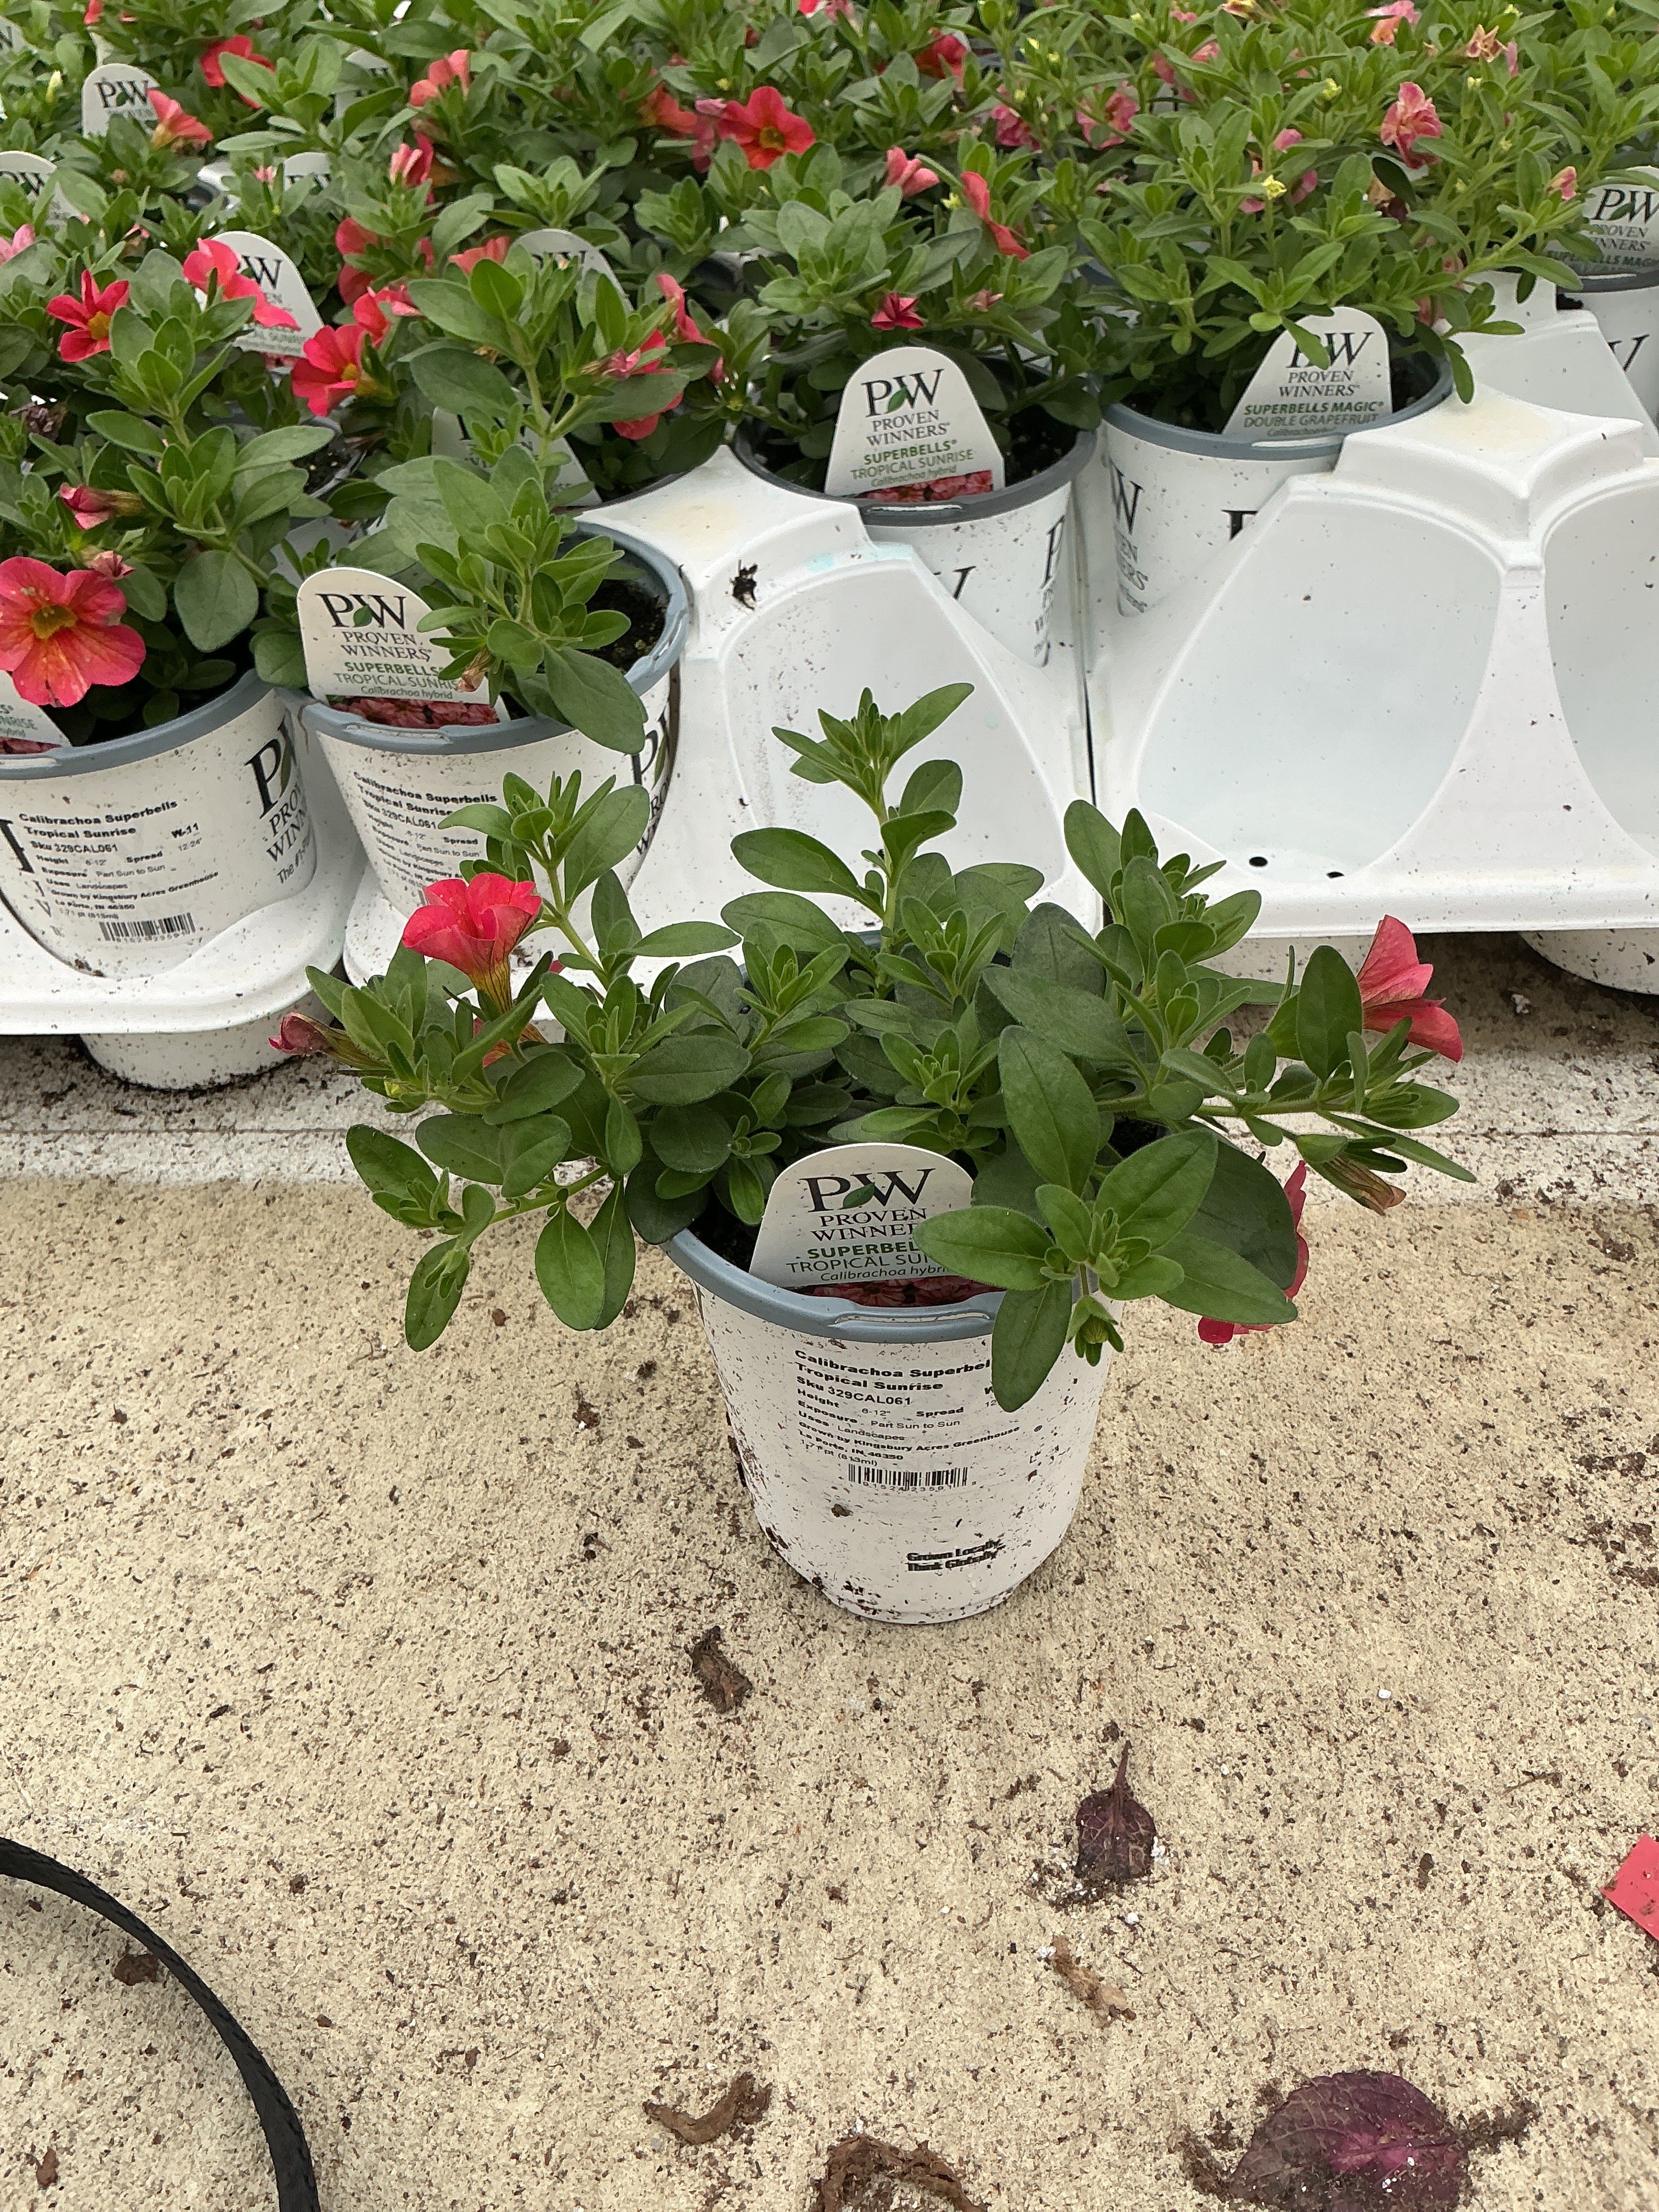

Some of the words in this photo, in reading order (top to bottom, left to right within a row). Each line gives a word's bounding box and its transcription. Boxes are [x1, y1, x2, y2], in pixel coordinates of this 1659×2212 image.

[1288, 370, 1353, 383] PROVEN
[861, 368, 945, 417] PW
[1279, 385, 1356, 397] WINNERS
[872, 409, 939, 432] PROVEN
[1243, 415, 1297, 428] DOUBLE
[1299, 413, 1379, 426] GRAPEFRUIT
[866, 423, 947, 447] WINNERS
[851, 459, 916, 480] TROPICAL
[918, 449, 975, 467] SUNRISE
[315, 593, 407, 630] PW
[342, 630, 417, 645] PROVEN
[340, 644, 431, 662] WINNERS
[333, 673, 407, 686] TROPICAL
[408, 676, 458, 690] SUNRIS
[360, 686, 419, 697] Calibrachoa
[421, 689, 453, 699] hybrid
[353, 771, 422, 800] Calibrachoa
[425, 792, 498, 805] Superbells
[357, 783, 403, 809] Tropical
[19, 813, 101, 825] Calibrachoa
[105, 801, 178, 823] Superbells
[23, 826, 80, 838] Tropical
[83, 827, 137, 838] Sunrise
[442, 836, 479, 845] Spread
[799, 1168, 936, 1212] PW
[819, 1207, 927, 1227] PROVEN
[810, 1223, 918, 1242] WINNE
[807, 1242, 921, 1259] SUPERBEL
[786, 1256, 890, 1273] TROPICAL
[820, 1267, 906, 1282] Calibrachoa
[910, 1265, 949, 1277] hybri
[795, 1350, 903, 1377] Calibrachoa
[909, 1359, 991, 1378] Superbel
[795, 1361, 867, 1388] Tropical
[873, 1381, 944, 1391] Sunrise
[797, 1375, 824, 1391] Sku
[827, 1386, 911, 1405] 329CAL061
[797, 1388, 840, 1408] Height
[916, 1406, 964, 1418] Spread
[798, 1400, 858, 1424] Exposure
[871, 1420, 894, 1429] Part
[798, 1410, 830, 1426] Uses
[837, 1425, 905, 1441] Landscapes
[798, 1421, 834, 1438] Grown
[837, 1435, 850, 1444] by
[854, 1439, 913, 1452] Kingsbury
[953, 1426, 1020, 1448] Greenhouse
[798, 1429, 812, 1440] La
[815, 1436, 848, 1453] Porte,
[867, 1452, 904, 1460] 46350
[824, 1449, 834, 1457] pt
[838, 1453, 878, 1466] (813ml)
